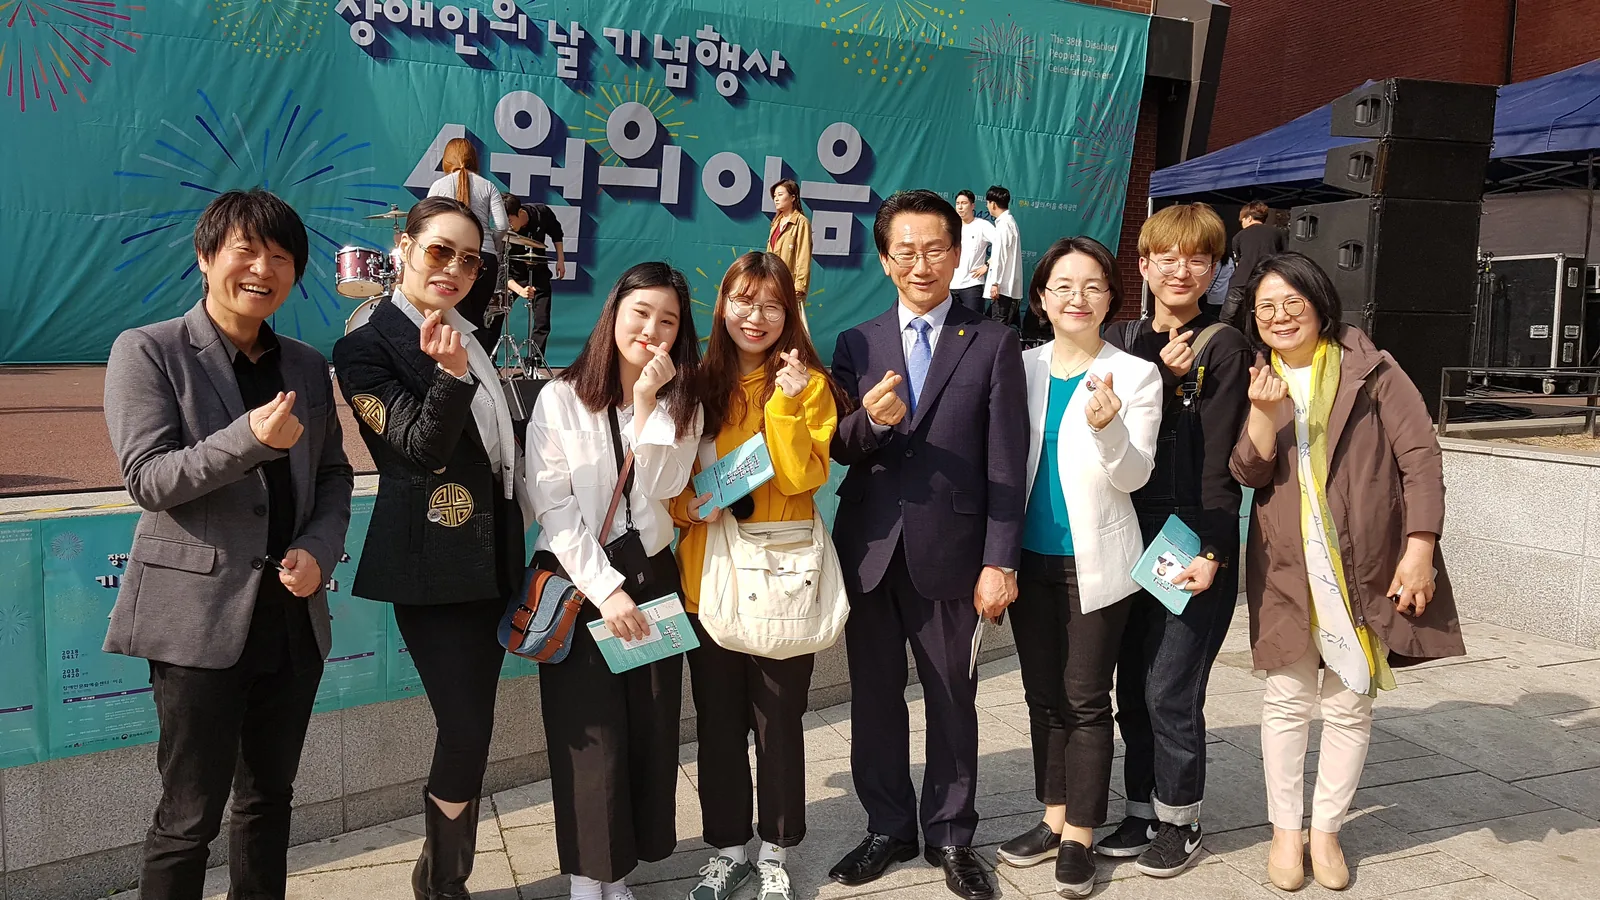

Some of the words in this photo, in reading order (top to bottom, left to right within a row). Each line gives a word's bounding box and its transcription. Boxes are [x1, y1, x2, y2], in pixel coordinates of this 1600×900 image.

[334, 0, 527, 55] 장애인의
[548, 19, 585, 79] 날
[602, 24, 786, 97] 기념행사
[1049, 33, 1064, 45] The
[1066, 36, 1082, 47] 38th
[1049, 48, 1080, 61] People's
[1083, 53, 1097, 65] Day
[702, 122, 871, 257] 이음
